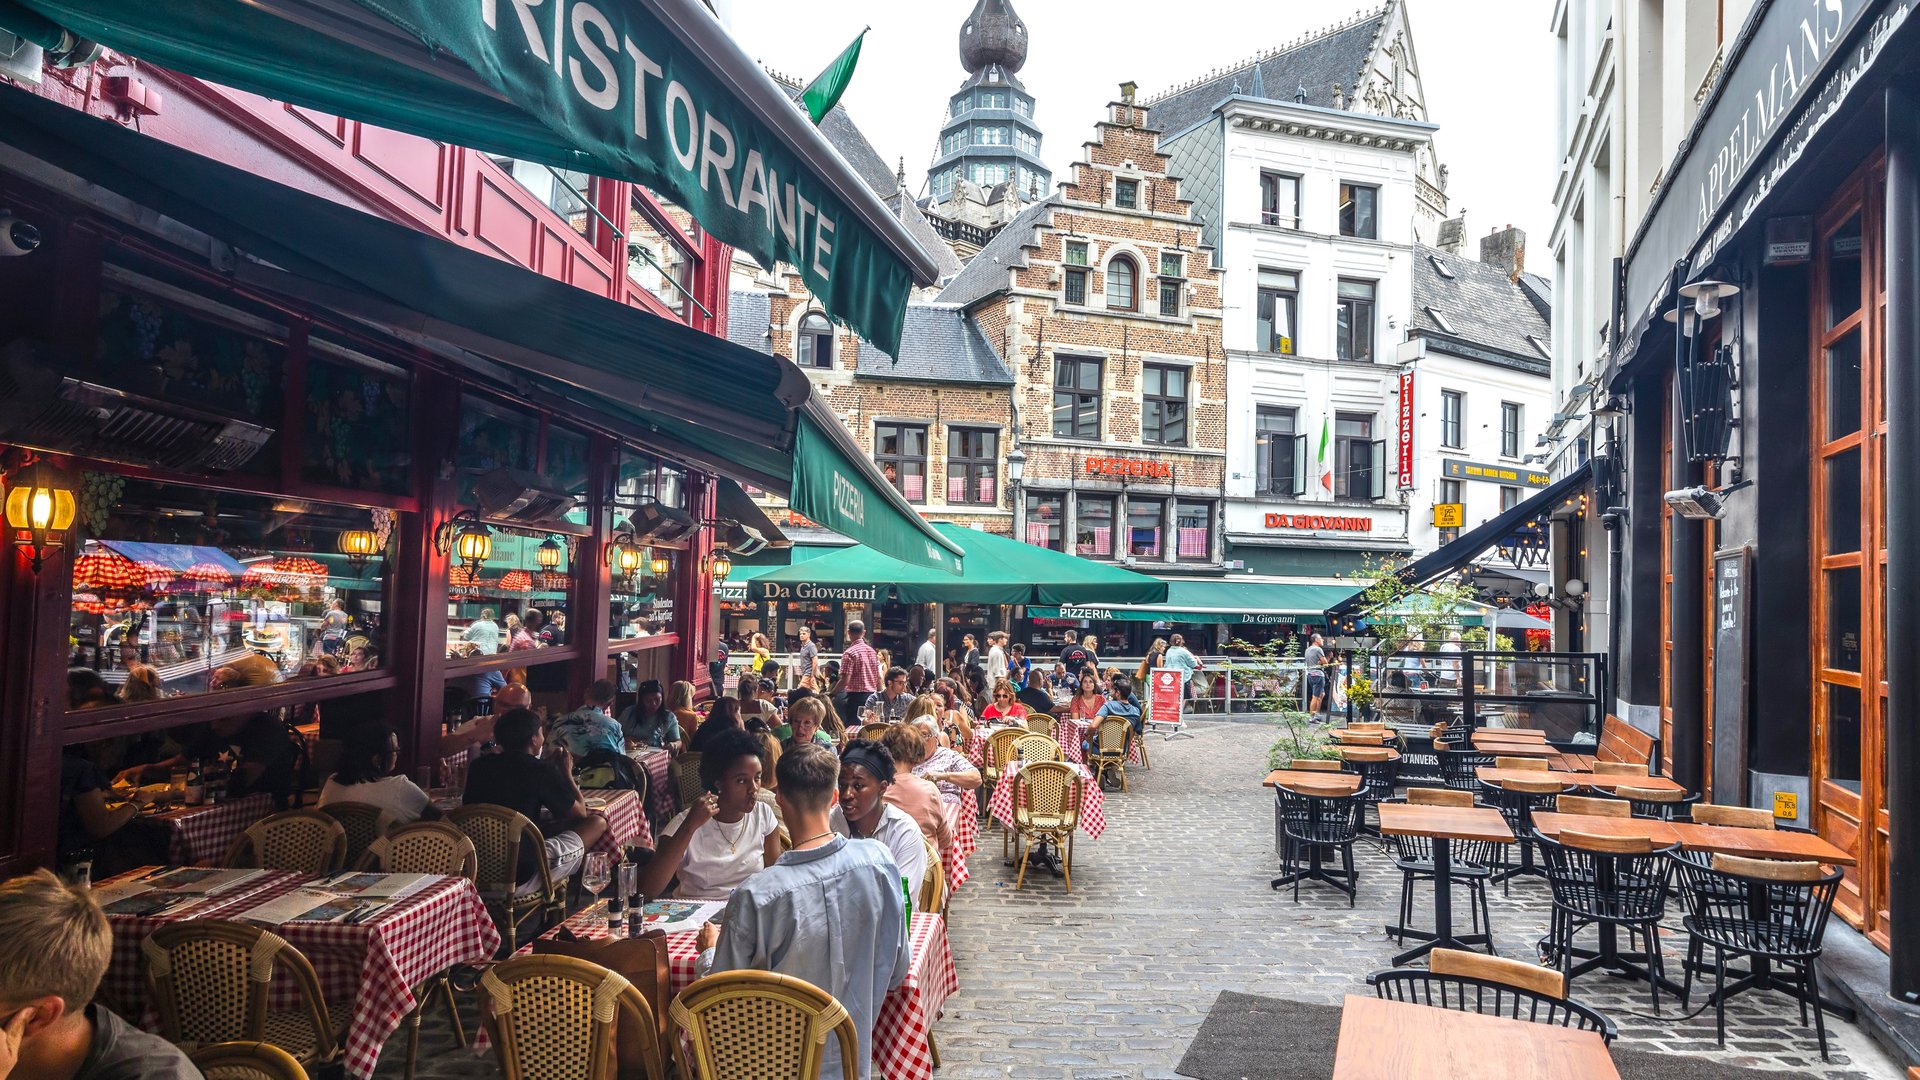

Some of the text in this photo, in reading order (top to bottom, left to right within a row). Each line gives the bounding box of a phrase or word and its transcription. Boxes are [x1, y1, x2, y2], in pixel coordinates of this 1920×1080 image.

[1696, 0, 1842, 233] APPELMANS
[1401, 375, 1412, 485] Pizzeria
[1086, 457, 1172, 478] PIZZERIA
[833, 470, 864, 527] PIZZERIA
[1265, 513, 1289, 529] DA
[1292, 514, 1373, 531] GIOVANNI
[763, 583, 876, 600] Da Giovanni
[652, 597, 673, 608] Studenten
[1060, 608, 1112, 619] PIZZERIA
[1242, 614, 1296, 624] Da Giovanni
[1402, 754, 1439, 765] D'ANVERS
